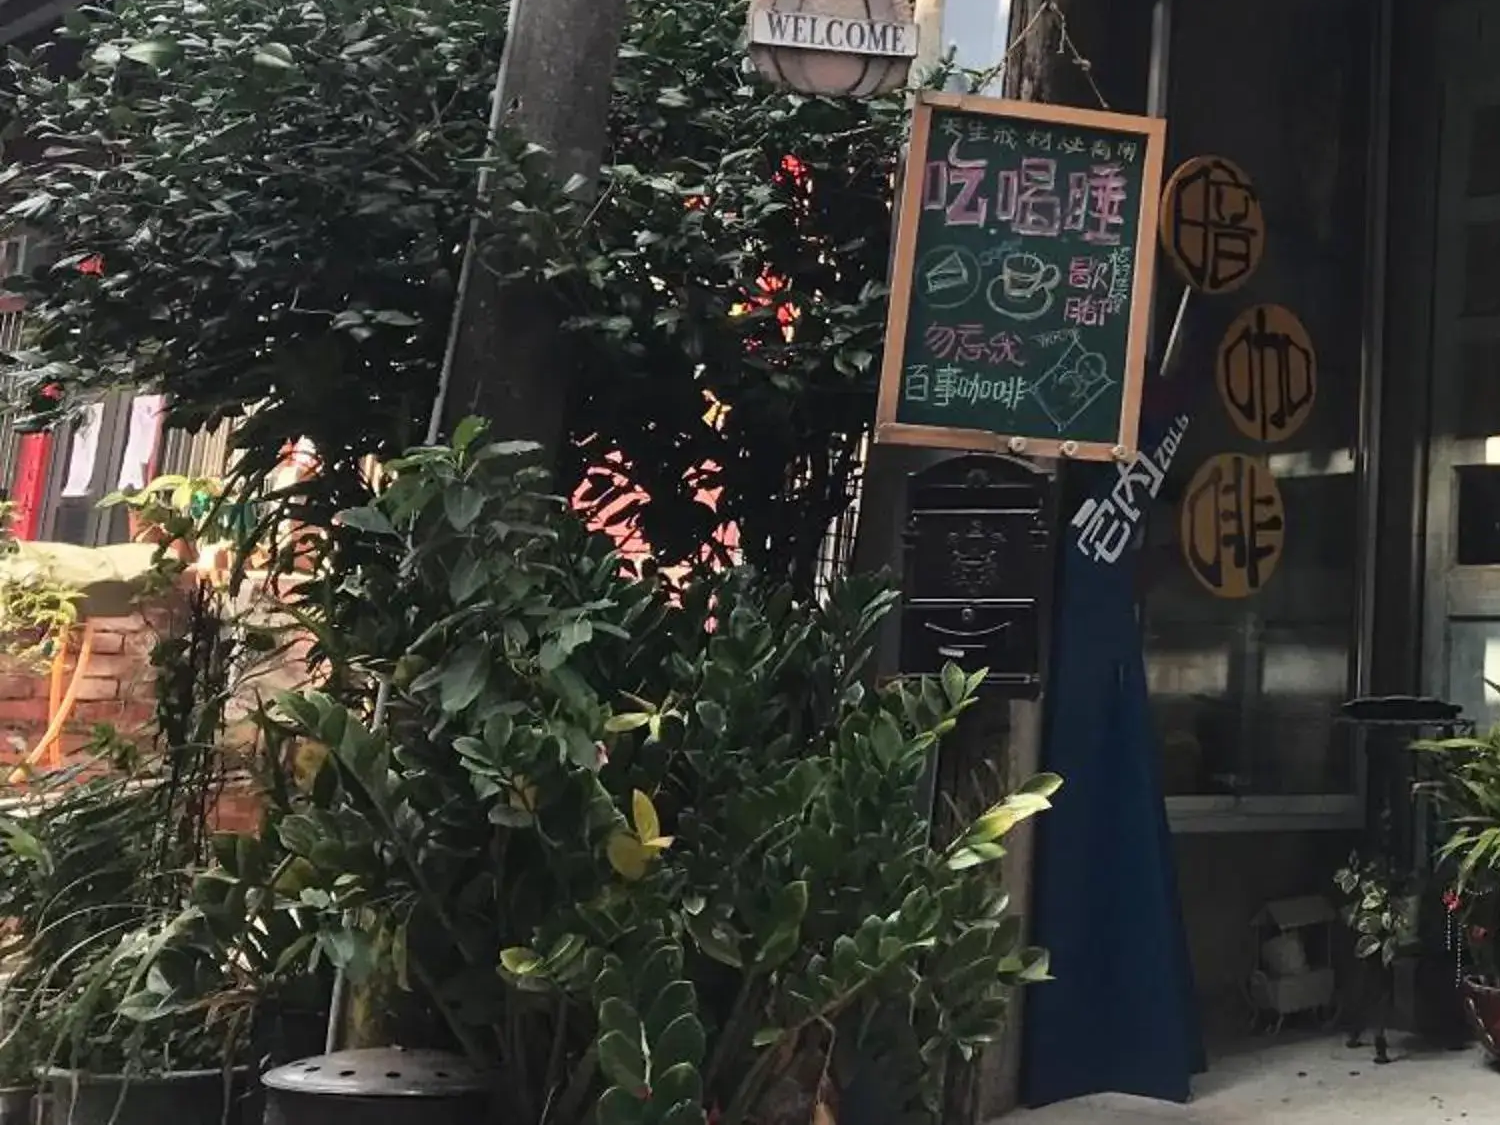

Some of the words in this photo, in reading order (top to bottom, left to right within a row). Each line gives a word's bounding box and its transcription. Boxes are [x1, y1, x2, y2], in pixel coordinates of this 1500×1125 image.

[766, 12, 907, 54] WELCOME
[923, 321, 1028, 368] 勿忘我
[904, 363, 1029, 412] 百事咖啡
